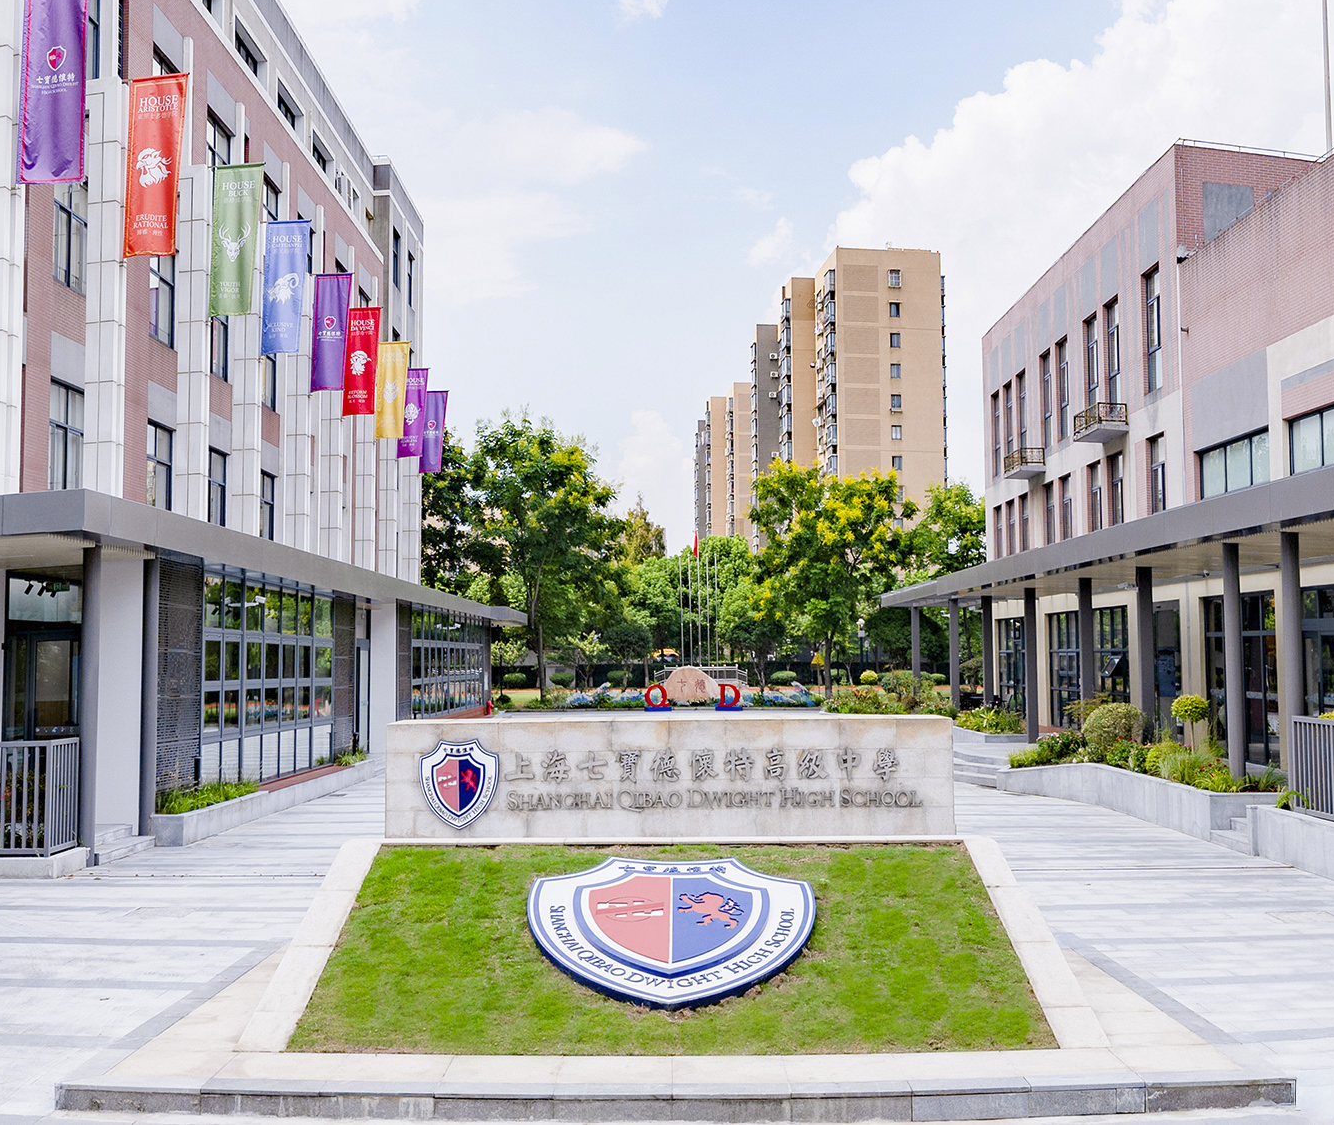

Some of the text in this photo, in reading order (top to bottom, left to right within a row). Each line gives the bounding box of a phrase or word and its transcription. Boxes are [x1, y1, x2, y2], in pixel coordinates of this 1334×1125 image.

[140, 95, 178, 107] HOUSE
[138, 102, 178, 113] ARISTOTLE
[222, 181, 255, 191] HOUSE
[229, 189, 249, 197] BUCK
[133, 221, 168, 229] RATIONAL
[273, 235, 303, 243] HOUSE
[645, 683, 741, 707] Q D
[507, 787, 923, 812] SHANGHAI QIBAO DWIGHT HIGH SCHOOL
[550, 905, 795, 989] SHANGHAI QIBAO DWIGHT HIGH SCHOOL
